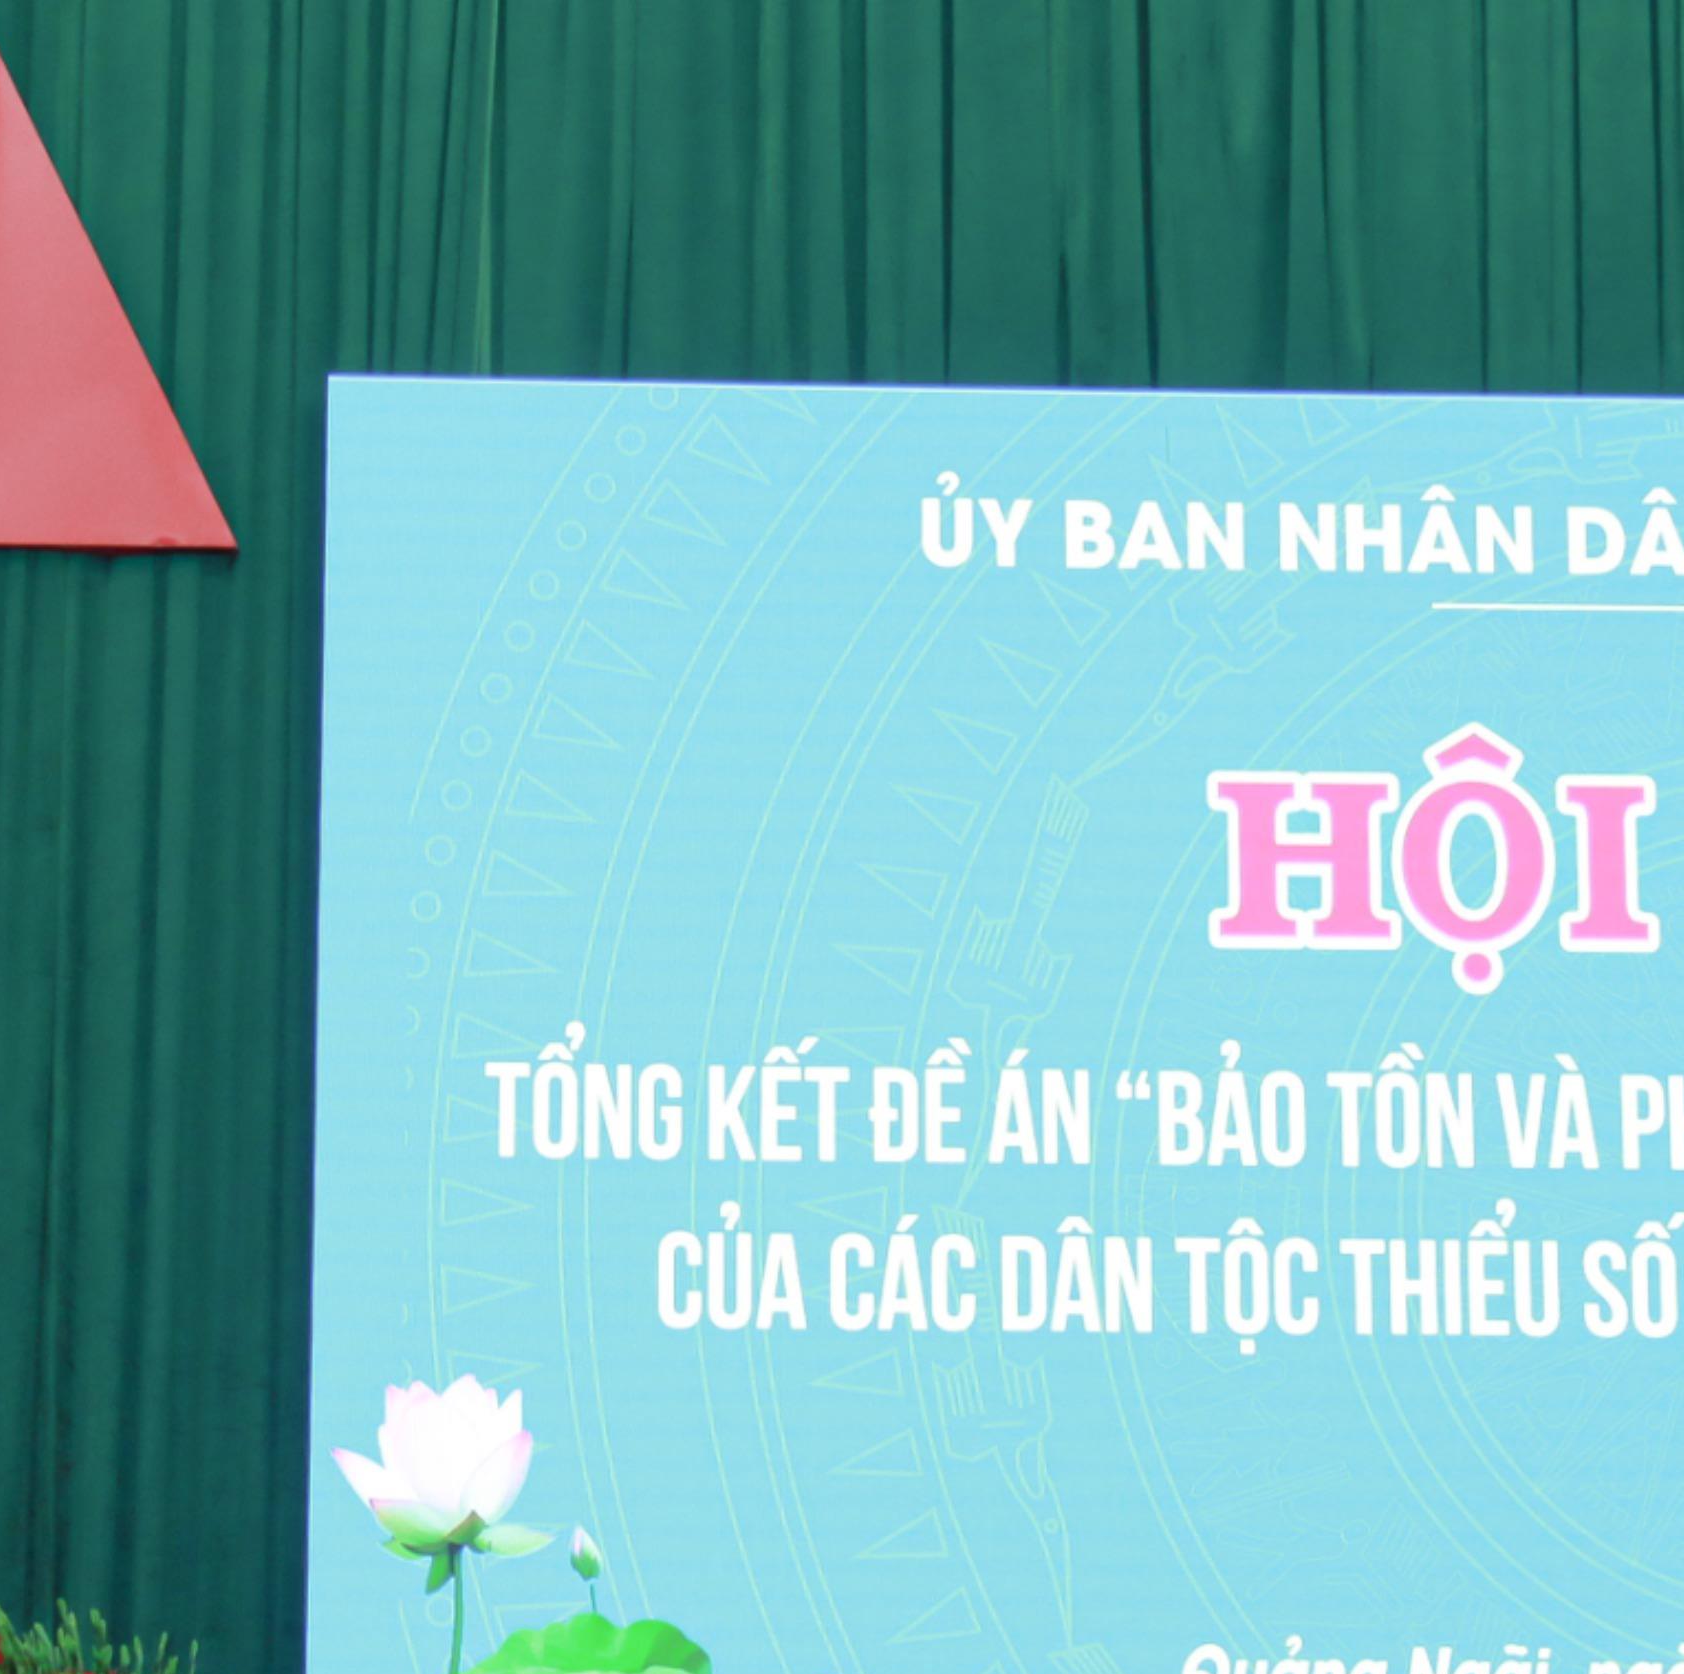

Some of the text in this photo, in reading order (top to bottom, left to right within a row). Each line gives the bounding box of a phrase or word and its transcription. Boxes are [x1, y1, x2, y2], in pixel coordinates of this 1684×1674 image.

[920, 470, 1033, 568] ỦY
[1064, 499, 1246, 572] BAN
[1278, 483, 1535, 574] NHÂN
[1206, 721, 1662, 996] HỘI
[484, 1019, 683, 1161] TỔNG
[707, 1035, 851, 1163] KẾT
[868, 1036, 972, 1164] ĐỀ
[987, 1047, 1091, 1165] ÁN
[1115, 1038, 1307, 1168] “BẢO
[1326, 1041, 1476, 1170] TỒN
[1495, 1053, 1600, 1170] VÀ
[657, 1200, 808, 1331] CỦA
[829, 1213, 977, 1333] CÁC
[1000, 1215, 1154, 1334] DÂN
[1174, 1217, 1320, 1356] TỘC
[1338, 1197, 1561, 1338] THIỂU
